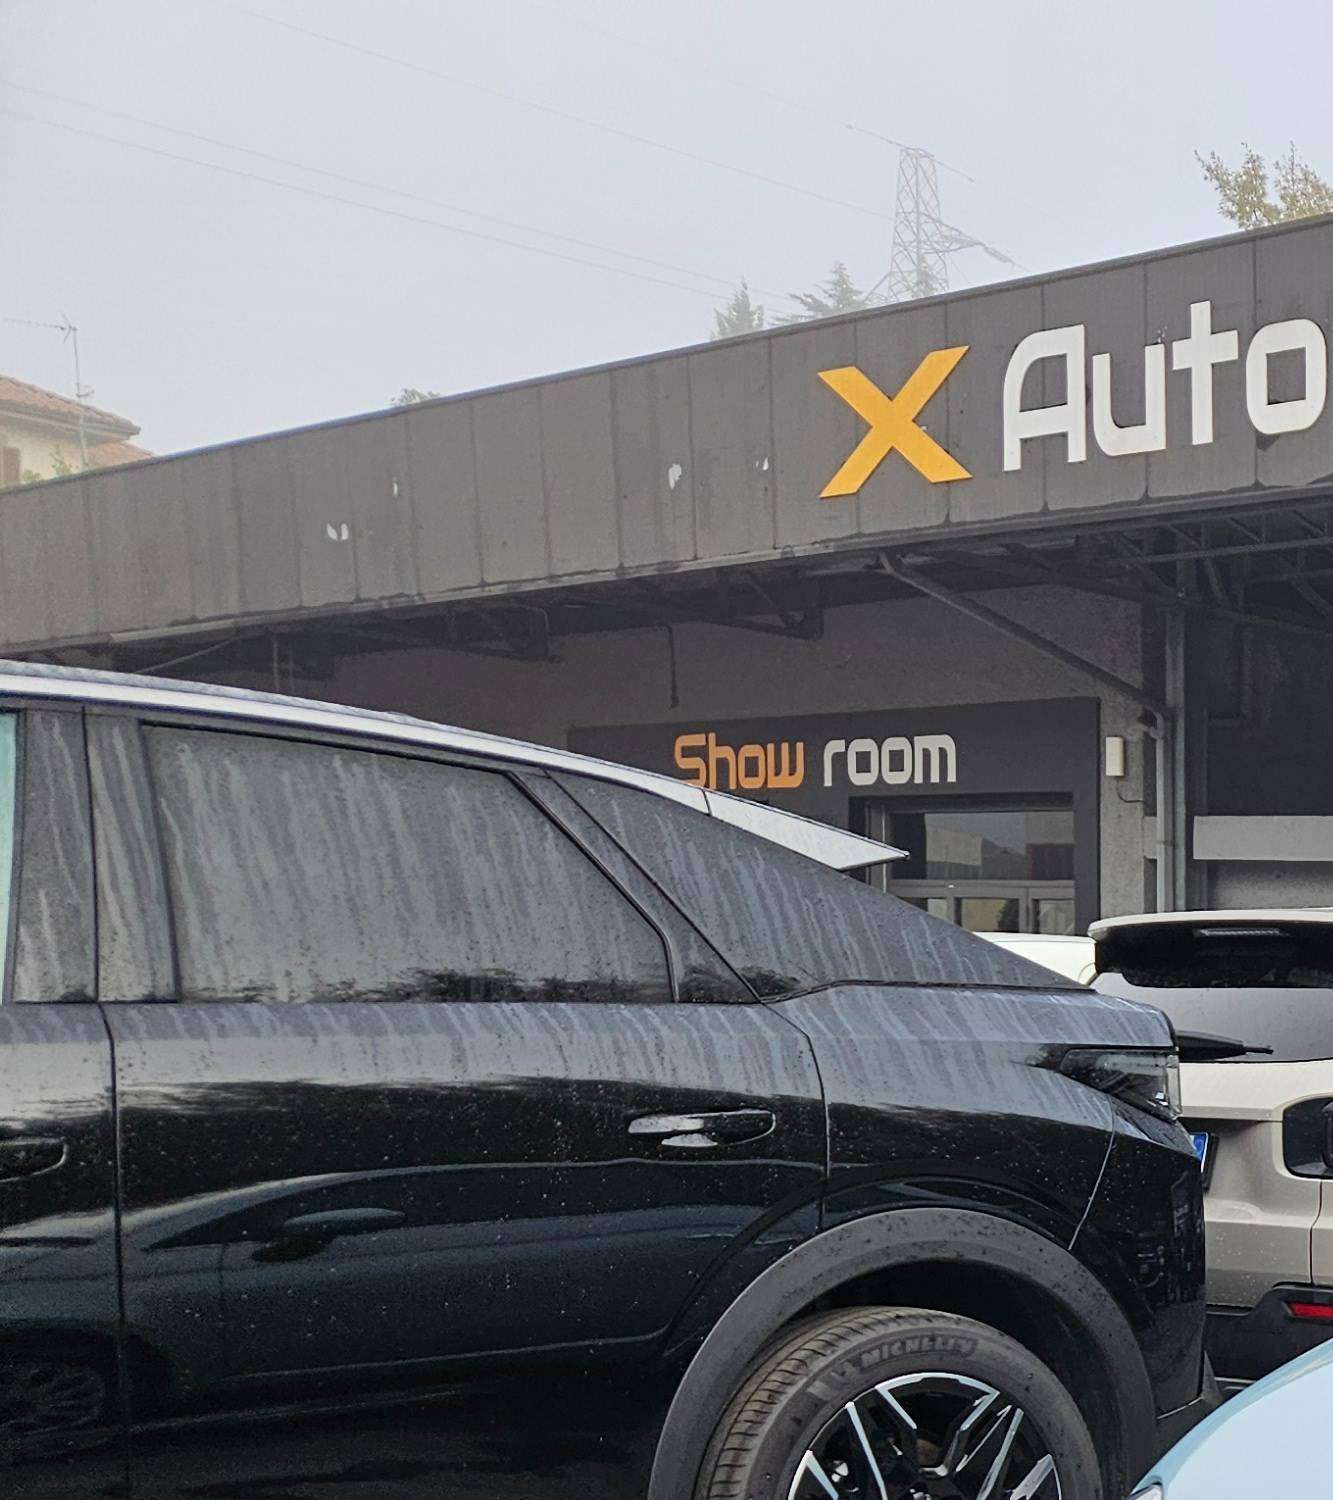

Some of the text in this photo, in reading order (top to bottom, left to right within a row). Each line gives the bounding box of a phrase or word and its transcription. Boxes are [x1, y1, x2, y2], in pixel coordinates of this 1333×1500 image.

[818, 300, 1327, 498] X Auto
[674, 732, 956, 789] Show room
